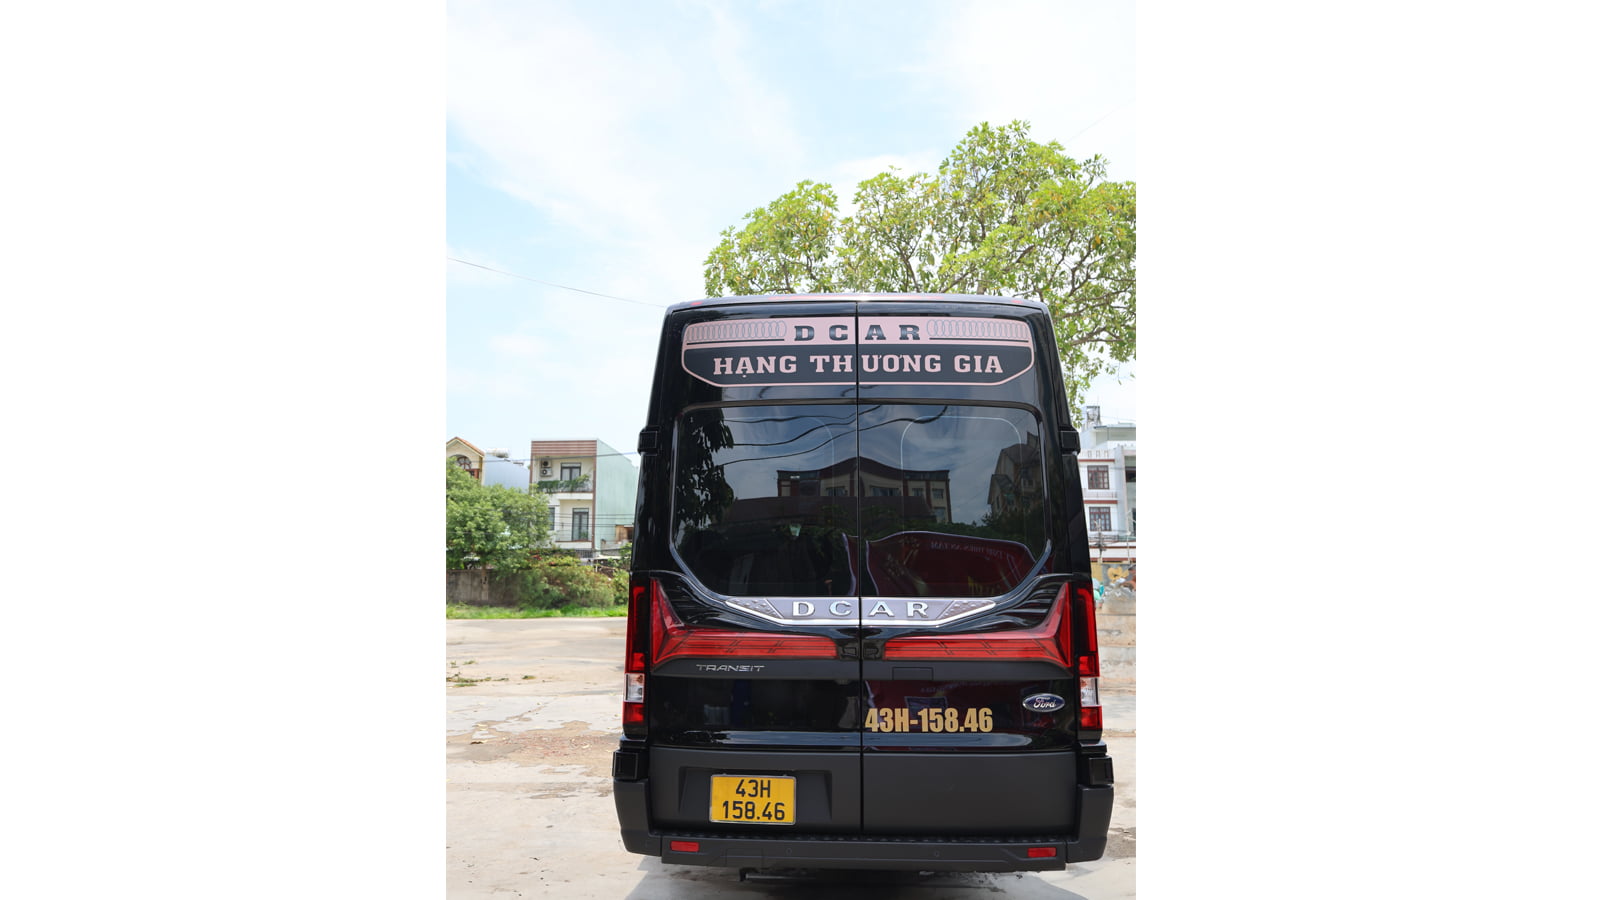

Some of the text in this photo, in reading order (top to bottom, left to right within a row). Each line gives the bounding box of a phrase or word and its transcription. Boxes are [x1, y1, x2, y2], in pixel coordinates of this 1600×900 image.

[793, 323, 921, 342] DCAR
[712, 354, 798, 379] HẠNG
[953, 354, 1004, 374] GIA
[792, 600, 930, 618] DCAR
[695, 663, 766, 672] TRANSIT
[1033, 696, 1057, 709] Ford
[864, 707, 994, 734] 43H-158.46
[735, 778, 772, 798] 43H
[722, 800, 786, 821] 158.46
